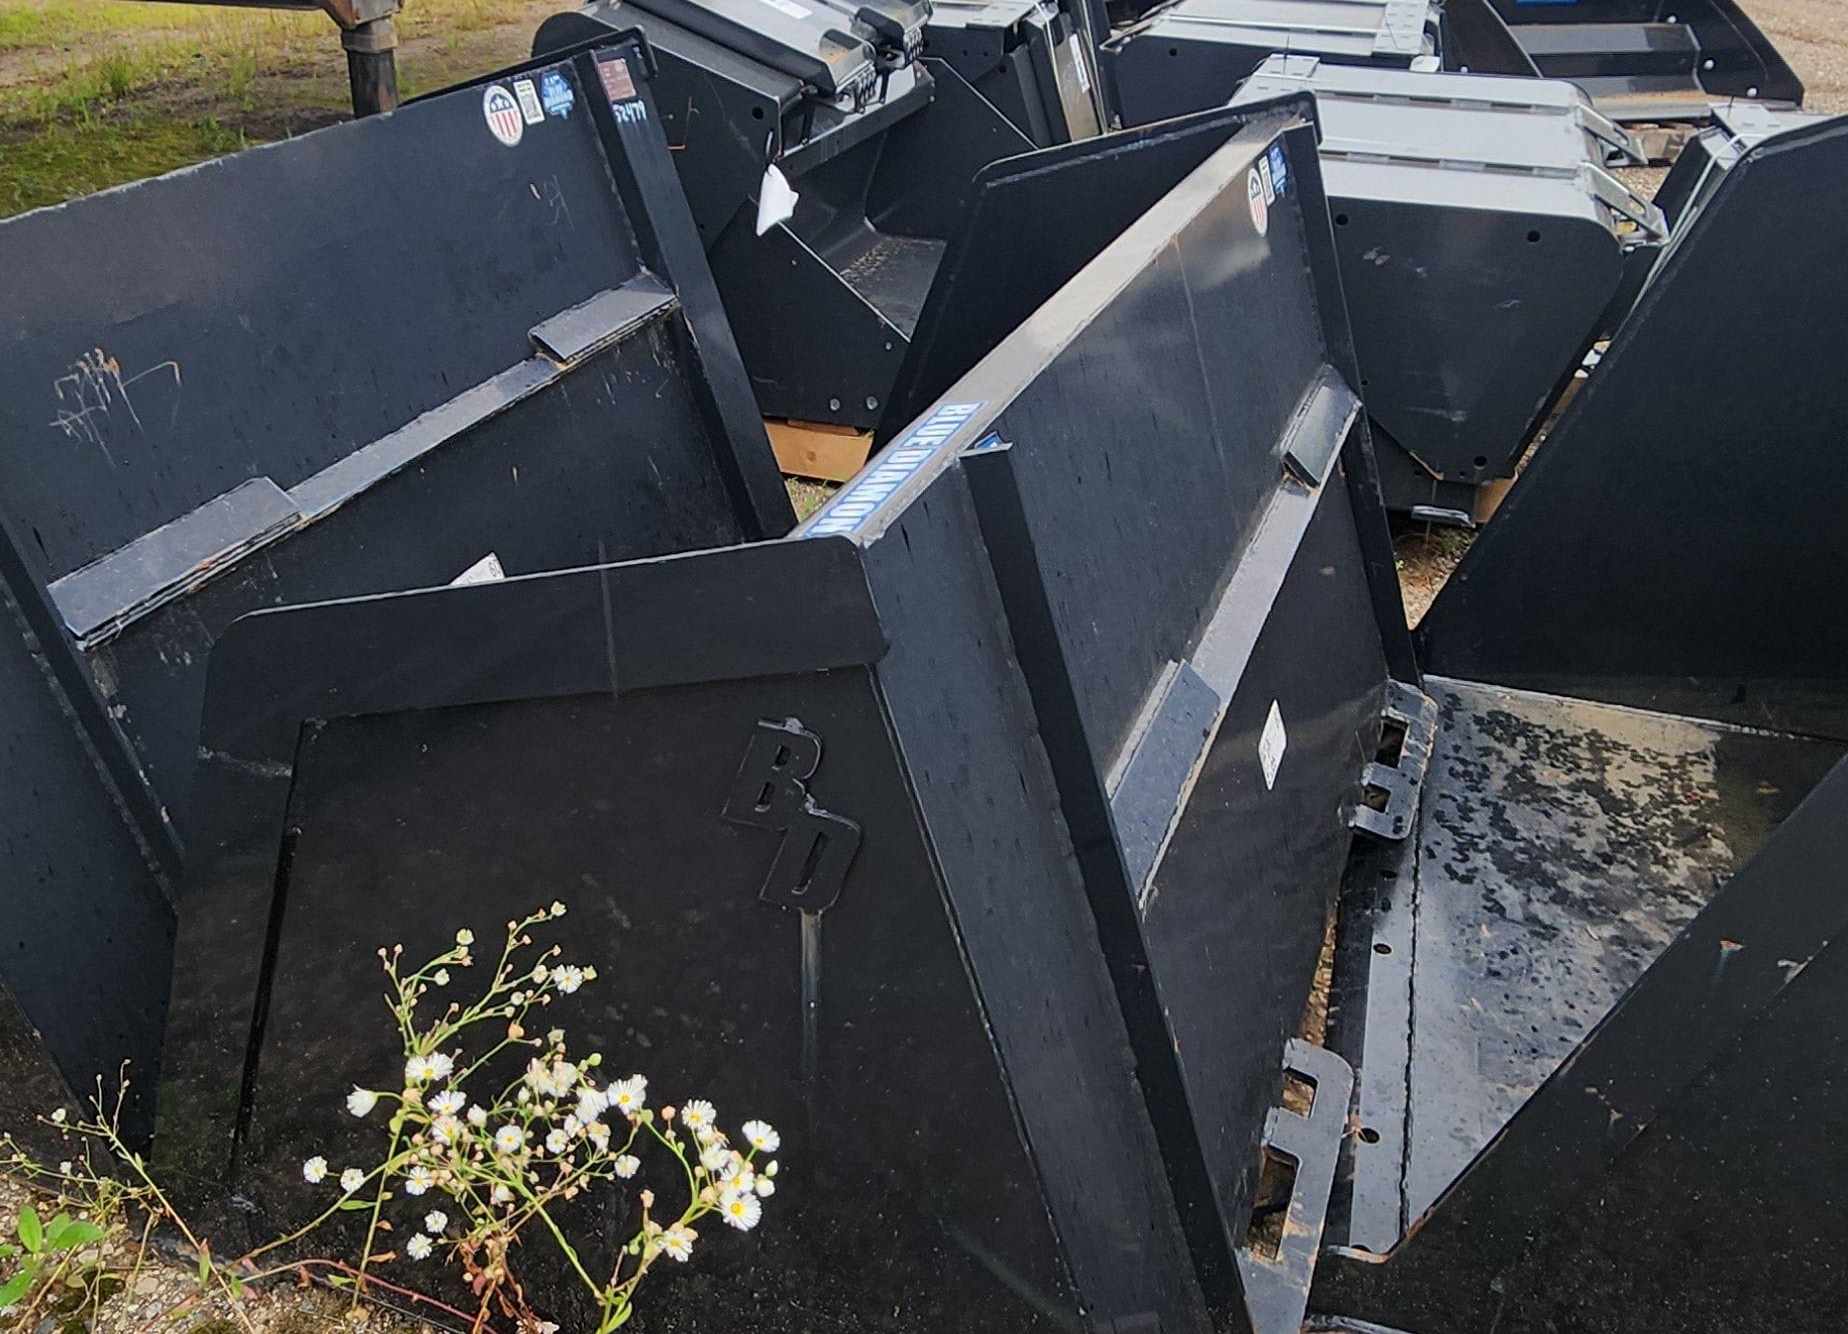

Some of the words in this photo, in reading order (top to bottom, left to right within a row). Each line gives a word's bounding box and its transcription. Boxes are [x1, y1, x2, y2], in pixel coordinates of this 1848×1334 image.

[903, 402, 981, 448] BLUE
[808, 448, 933, 534] DIAMON
[719, 716, 865, 912] BD
